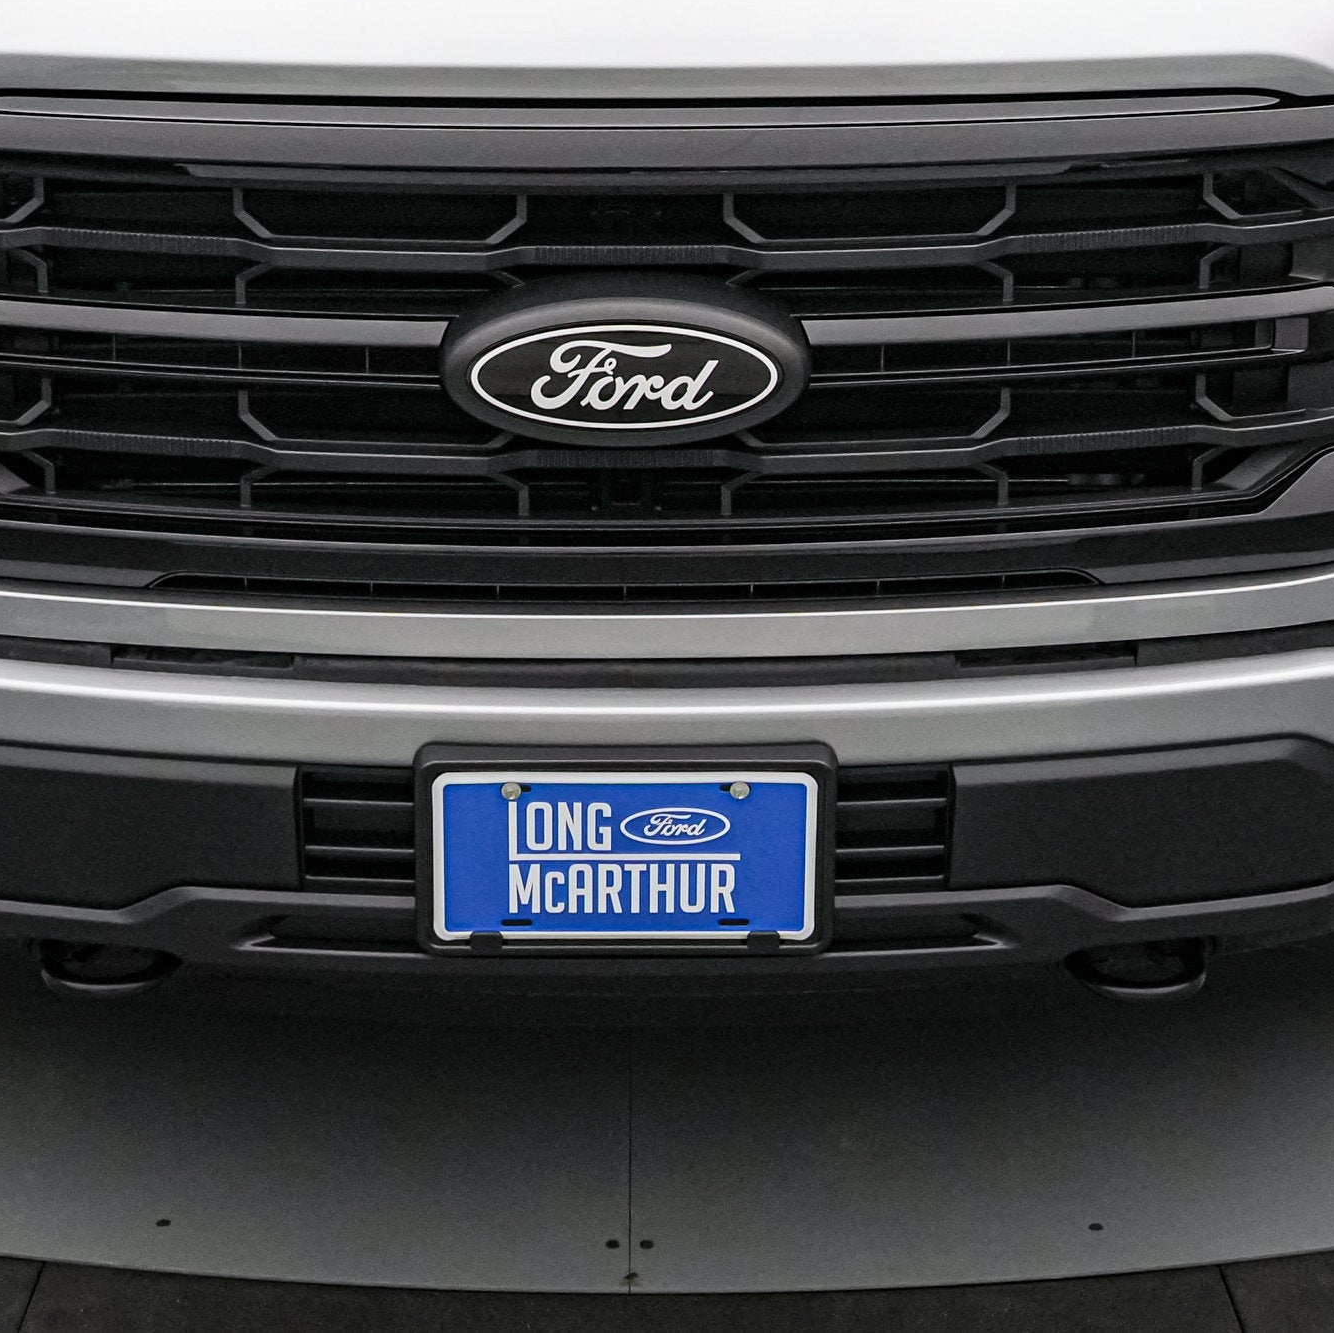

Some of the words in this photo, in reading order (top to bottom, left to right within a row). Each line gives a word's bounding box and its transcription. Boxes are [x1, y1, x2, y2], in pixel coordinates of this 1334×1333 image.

[531, 340, 718, 410] Ford
[509, 802, 612, 859] LONG
[643, 813, 706, 837] Ford
[509, 863, 735, 914] McARTHUR
